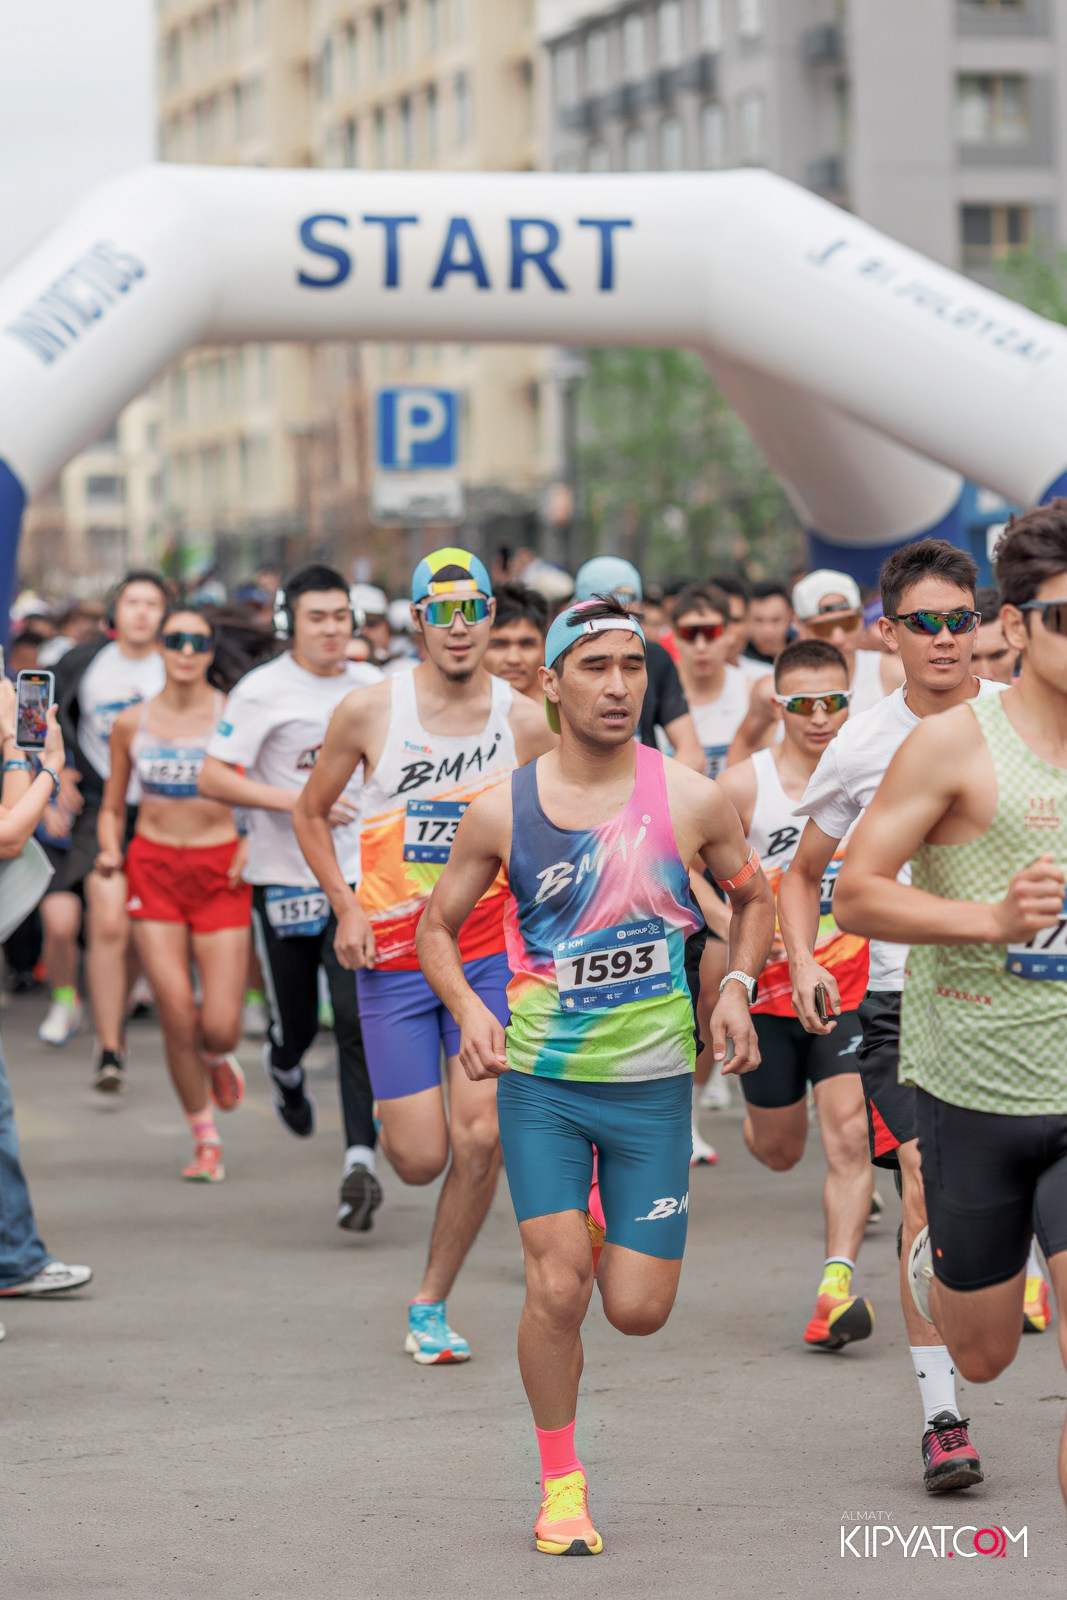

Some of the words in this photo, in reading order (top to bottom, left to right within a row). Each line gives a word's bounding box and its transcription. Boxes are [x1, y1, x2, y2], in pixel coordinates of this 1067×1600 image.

[296, 214, 633, 291] START
[397, 391, 446, 468] P
[280, 899, 326, 920] 1512
[557, 942, 566, 951] 5
[568, 939, 584, 949] KM
[626, 927, 648, 937] GROUP
[571, 945, 655, 986] 1593
